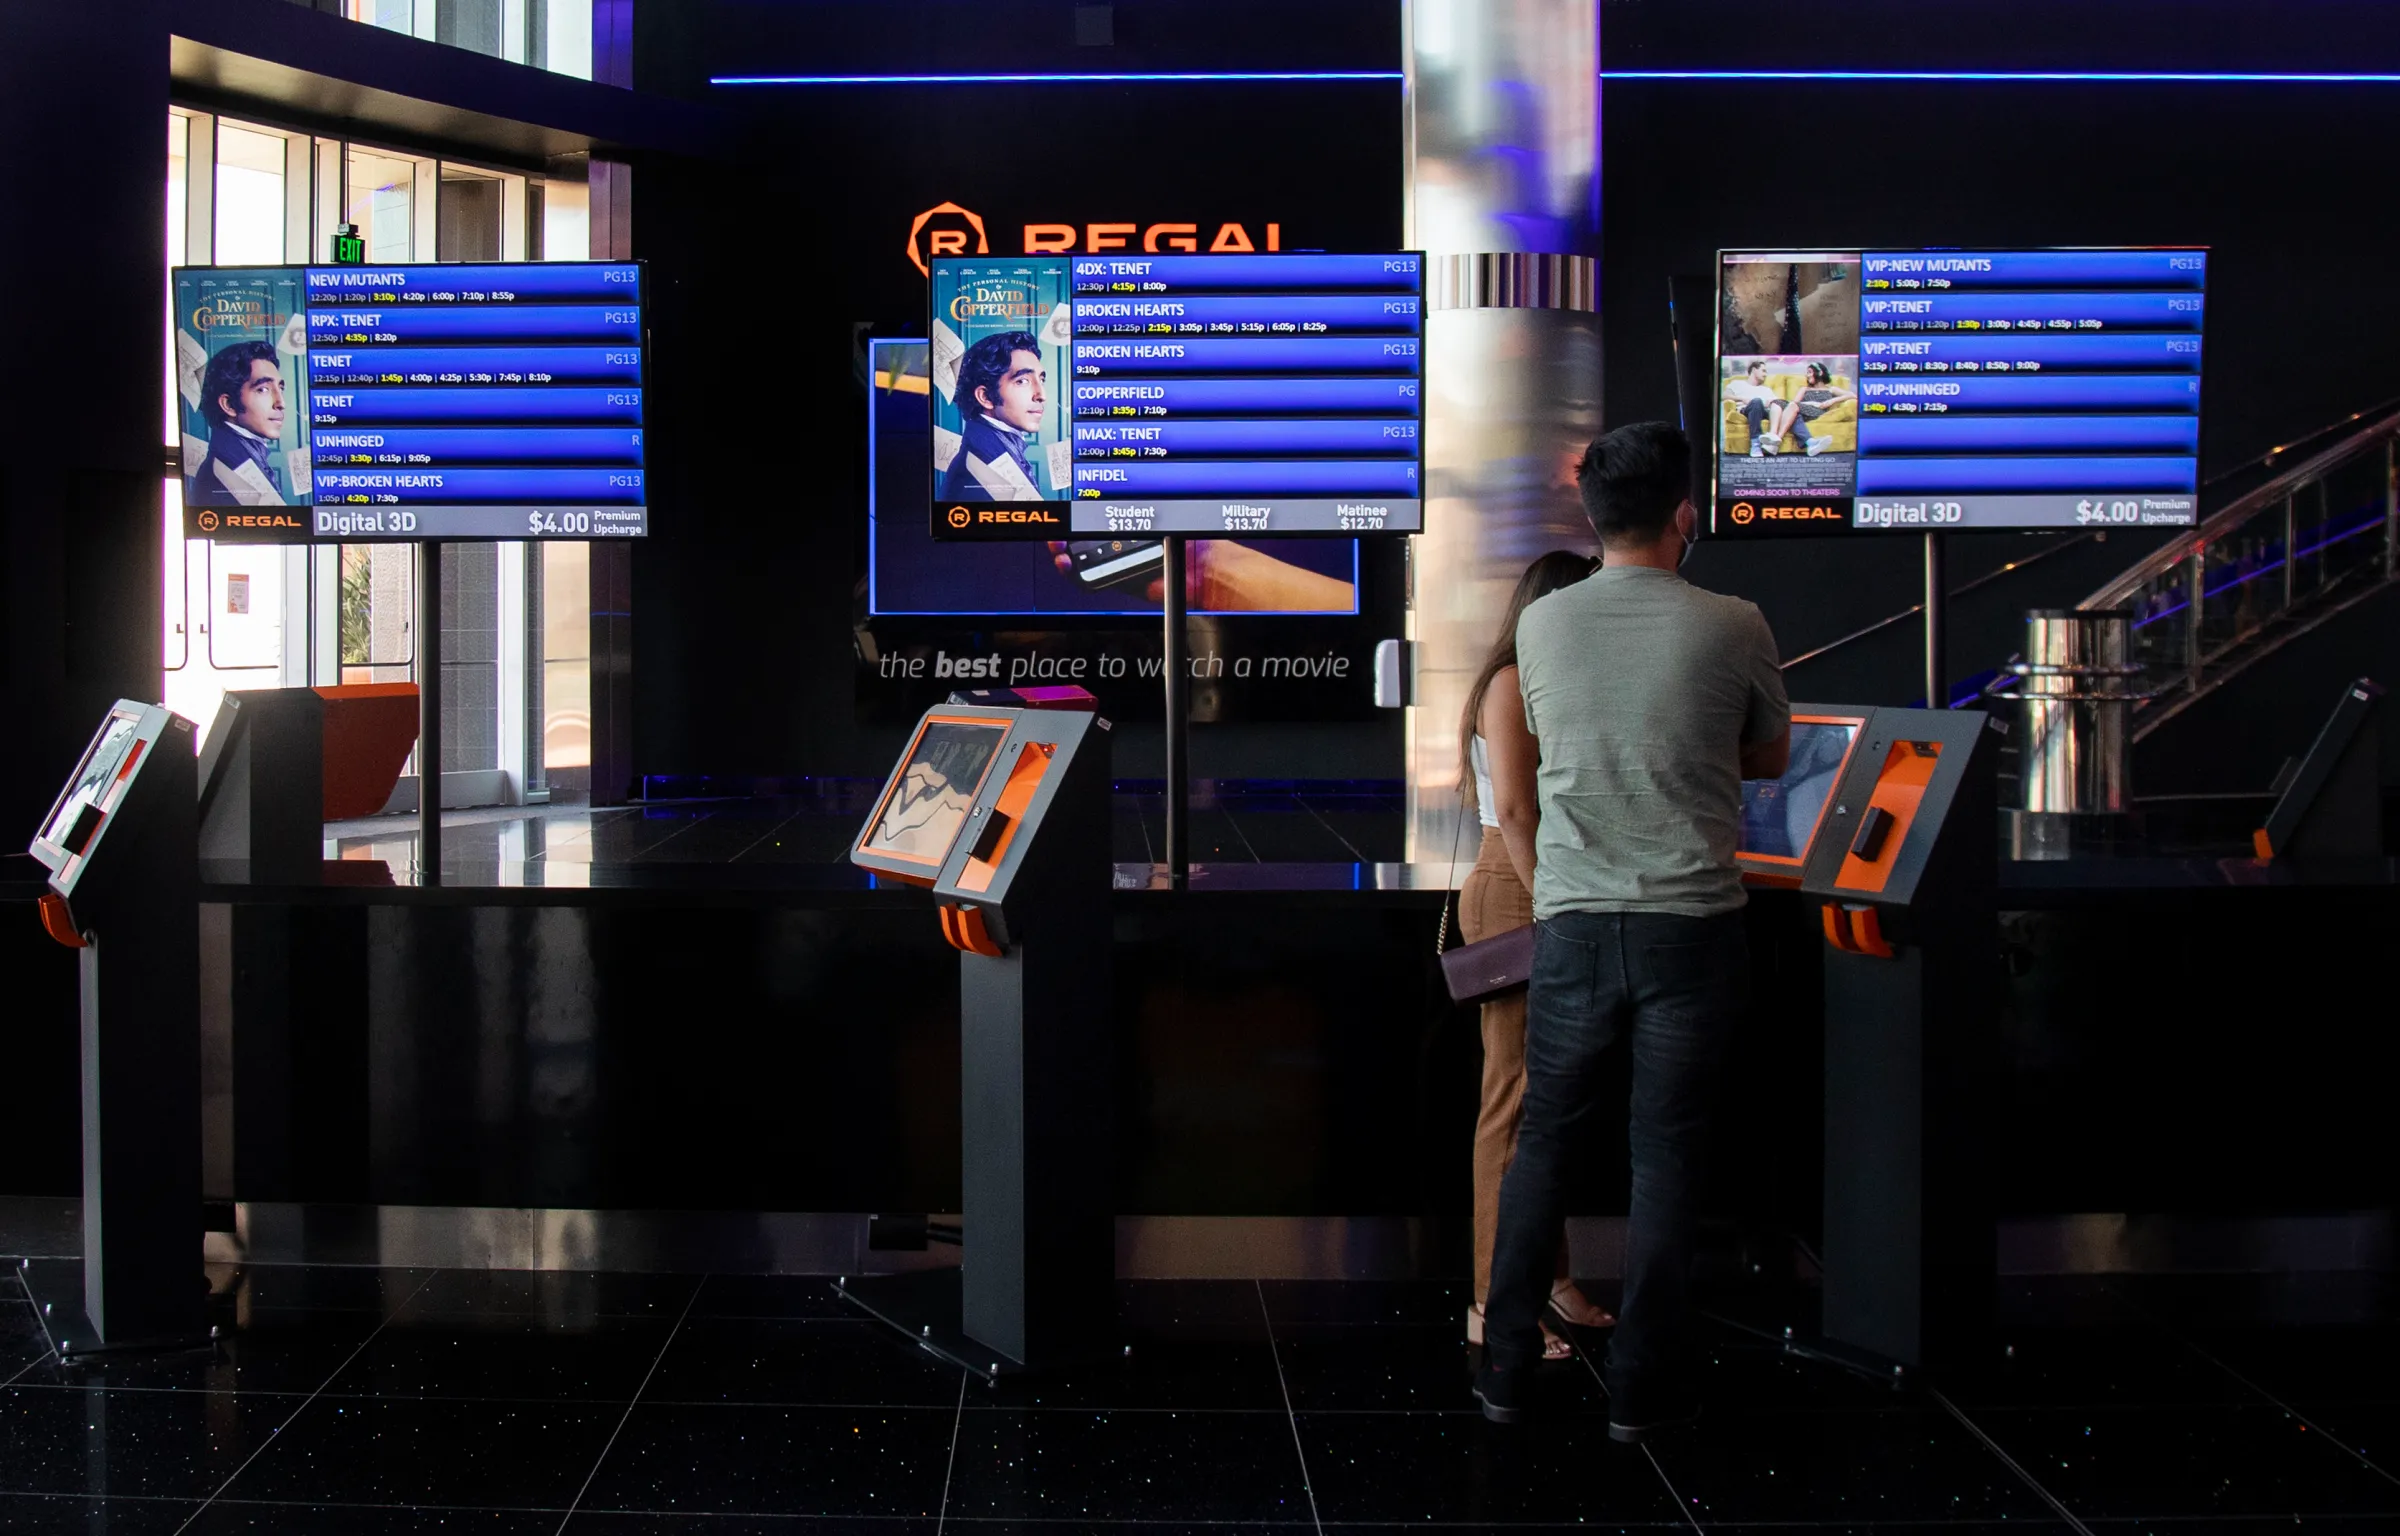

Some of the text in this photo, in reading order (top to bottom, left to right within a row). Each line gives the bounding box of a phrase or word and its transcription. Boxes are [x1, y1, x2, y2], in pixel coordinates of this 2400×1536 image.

[340, 237, 361, 263] EXIT
[1384, 261, 1417, 272] PG13
[1866, 259, 1991, 271] VIP:NEW MUTANTS
[2170, 257, 2203, 269] PG13
[1076, 263, 1152, 275] 4DX: TENET
[310, 274, 340, 286] NEW
[344, 273, 405, 285] MUTANTS
[604, 271, 635, 282] PG13
[1077, 282, 1166, 291] 12:30p 4:15p 8:00p
[311, 292, 514, 302] 12:20p 1:20p 3:10p 4:20p 6:00p 7:10p 8:55p
[976, 288, 1023, 302] DAVID
[218, 299, 260, 312] DAVID
[950, 296, 1050, 322] COPPERFIELD
[1077, 304, 1184, 316] BROKEN HEARTS
[1384, 302, 1417, 313] PG13
[1865, 301, 1932, 313] VIP:TENET
[2168, 299, 2201, 310] PG13
[193, 307, 285, 332] COPPERFIELD
[311, 314, 381, 326] RPX: TENET
[605, 312, 636, 323] PG13
[1078, 322, 1327, 333] 12:00p 12:25p 2:15p 3:05p 3:45p 5:15p 6:05p 8:25p
[312, 334, 397, 342] 12:50p 4:35p 8:20p
[1077, 345, 1184, 358] BROKEN HEARTS
[1384, 344, 1416, 355] PG13
[1864, 342, 1931, 354] VIP:TENET
[2167, 341, 2199, 352] PG13
[312, 355, 352, 367] TENET
[606, 354, 638, 364] PG13
[1077, 366, 1100, 374] 9:10p
[314, 375, 340, 383] 12:15p
[382, 374, 403, 383] 1:45p
[410, 374, 432, 382] 4:00p
[440, 374, 462, 382] 4:25p
[470, 374, 491, 382] 5:30p
[499, 373, 521, 382] 7:45p
[529, 373, 551, 382] 8:10p
[1077, 387, 1164, 399] COPPERFIELD
[1399, 385, 1415, 396] PG
[1863, 383, 1960, 395] VIP:UNHINGED
[314, 395, 354, 407] TENET
[608, 394, 638, 405] PG13
[1076, 406, 1167, 415] 12:10p 3:35p 7:10p
[315, 415, 337, 423] 9:15p
[1078, 428, 1162, 440] IMAX: TENET
[1384, 427, 1416, 437] PG13
[316, 435, 384, 447] UNHINGED
[632, 435, 639, 445] R
[1078, 447, 1167, 456] 12:00p 3:45p 7:30p
[318, 454, 430, 463] 12:45p 3:30p 6:15p 9:05p
[1078, 469, 1127, 481] INFIDEL
[1407, 468, 1415, 478] R
[317, 476, 443, 487] VIP:BROKEN HEARTS
[610, 476, 640, 486] PG13
[1078, 489, 1100, 498] 7:00p
[317, 494, 399, 505] 1:05p 4:20p 7:30p
[2144, 500, 2190, 510] Premium
[594, 511, 640, 521] Premium
[1105, 506, 1155, 517] Student
[1222, 505, 1270, 520] Military
[1337, 505, 1387, 516] Matinee
[1762, 508, 1842, 519] REGAL
[1859, 500, 2138, 527] Digital 3D $4.00
[226, 516, 302, 526] REGAL
[979, 511, 1060, 522] REGAL
[2143, 513, 2191, 525] Upcharge
[318, 511, 589, 535] Digital 3D $4.00
[1109, 518, 1151, 531] $13.70
[1224, 518, 1267, 530] $13.70
[1341, 517, 1383, 530] $12.70
[594, 524, 642, 535] Upcharge
[880, 651, 1349, 685] the best place to wch a movie
